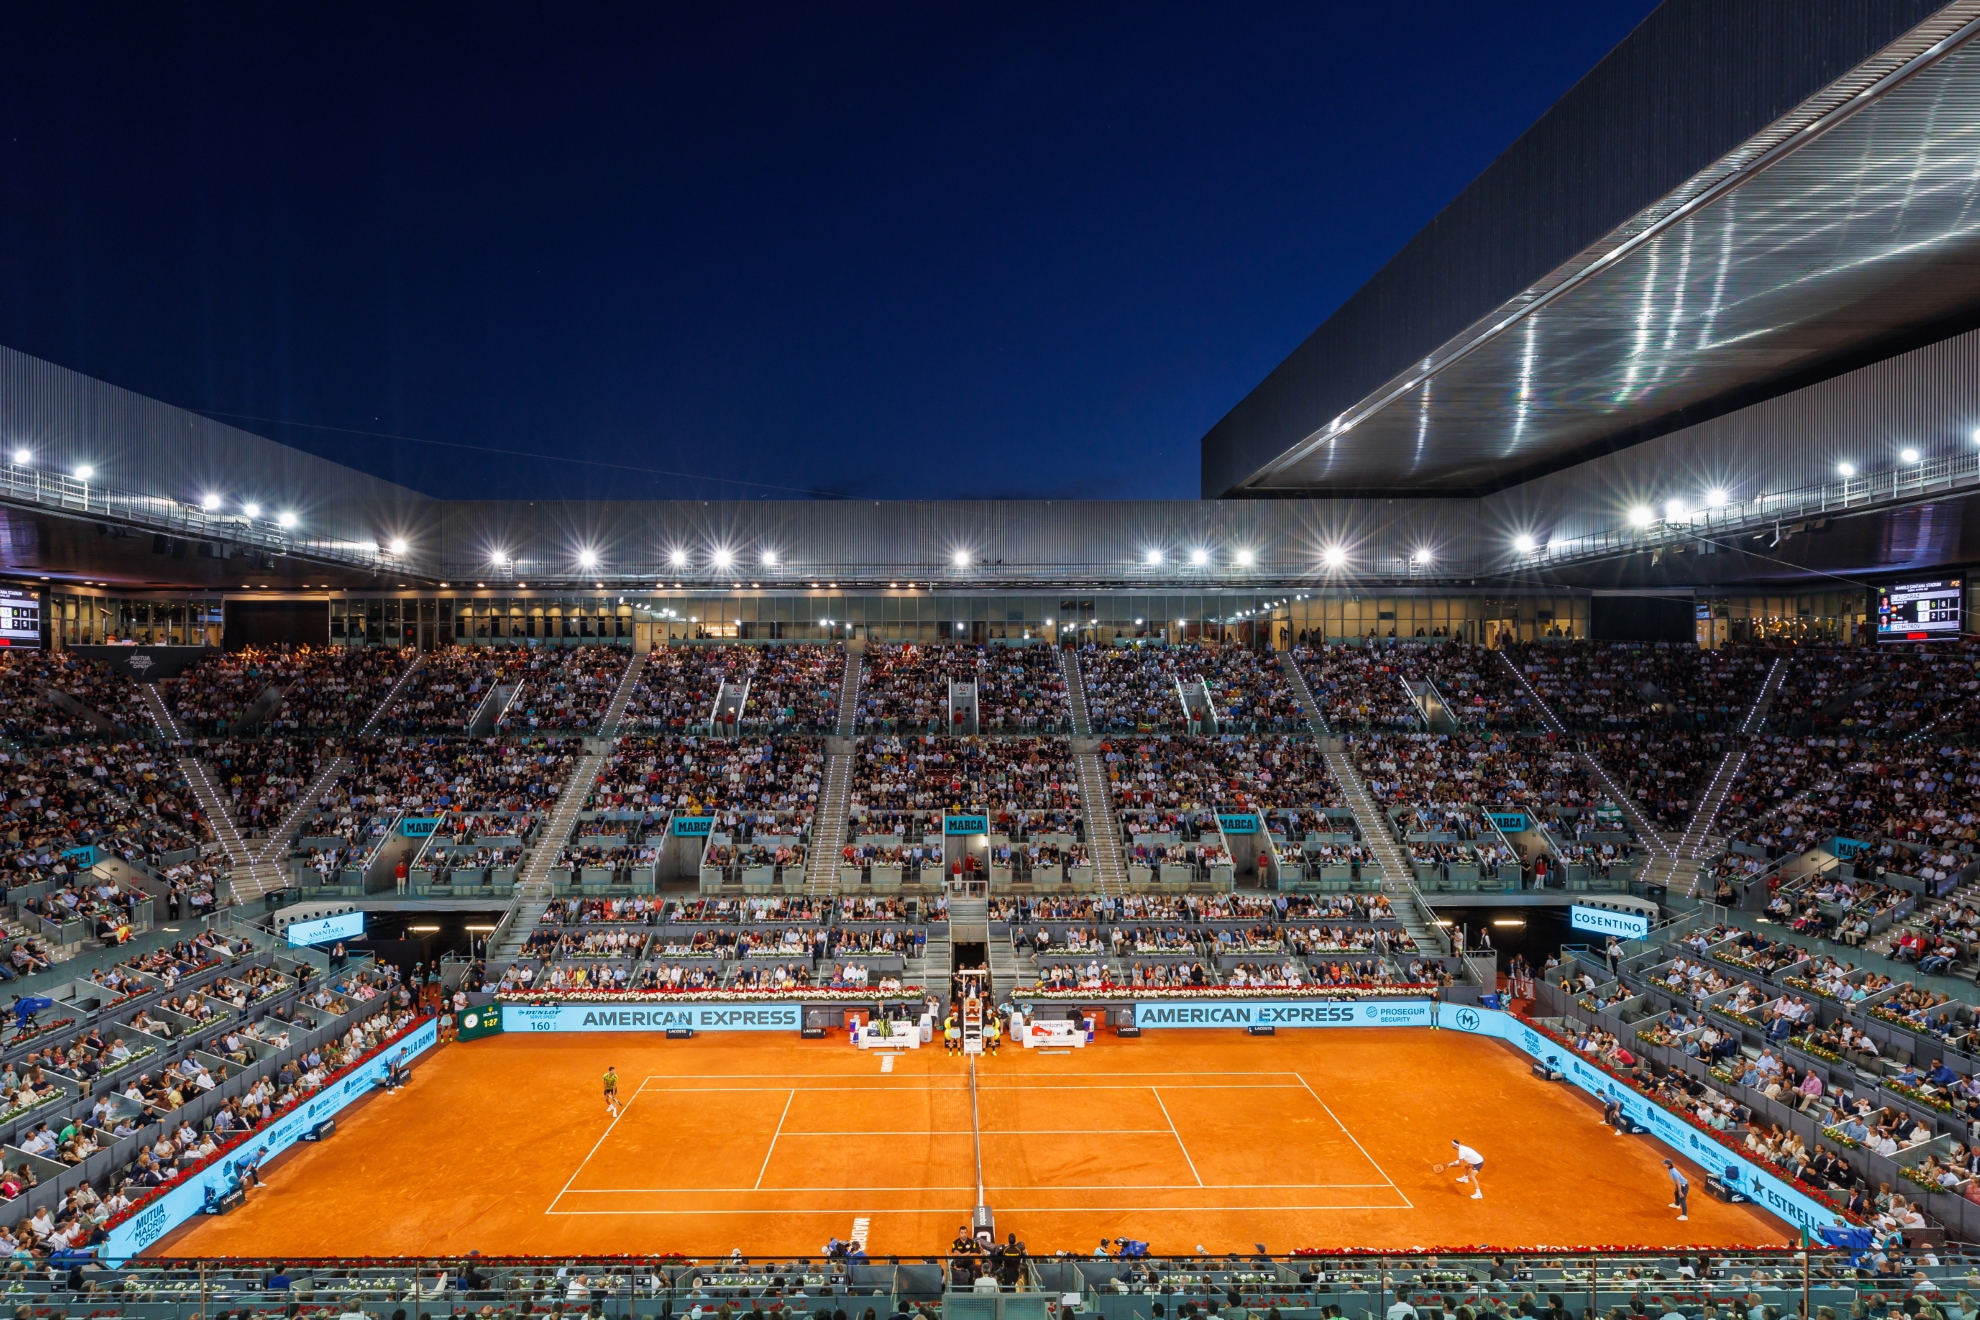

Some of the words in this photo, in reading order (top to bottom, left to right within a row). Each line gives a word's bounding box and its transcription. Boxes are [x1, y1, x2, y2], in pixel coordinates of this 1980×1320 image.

[406, 822, 437, 833] MARC
[678, 822, 712, 832] MARCA
[948, 820, 983, 830] MARCA
[1220, 819, 1253, 829] MARCA
[1574, 913, 1640, 933] COSENTINO
[308, 926, 345, 939] ANANTARA
[483, 1017, 498, 1028] 1:27
[582, 1011, 692, 1026] AMERICAN
[700, 1010, 796, 1026] EXPRESS
[1141, 1008, 1251, 1023] AMERICAN
[1259, 1007, 1354, 1022] EXPRESS
[531, 1021, 550, 1030] 160
[1707, 1179, 1726, 1194] LACOSTE
[222, 1190, 243, 1205] LACOSTE
[135, 1203, 165, 1231] MUTUA
[134, 1213, 166, 1242] MADRID
[138, 1225, 162, 1248] OPEN
